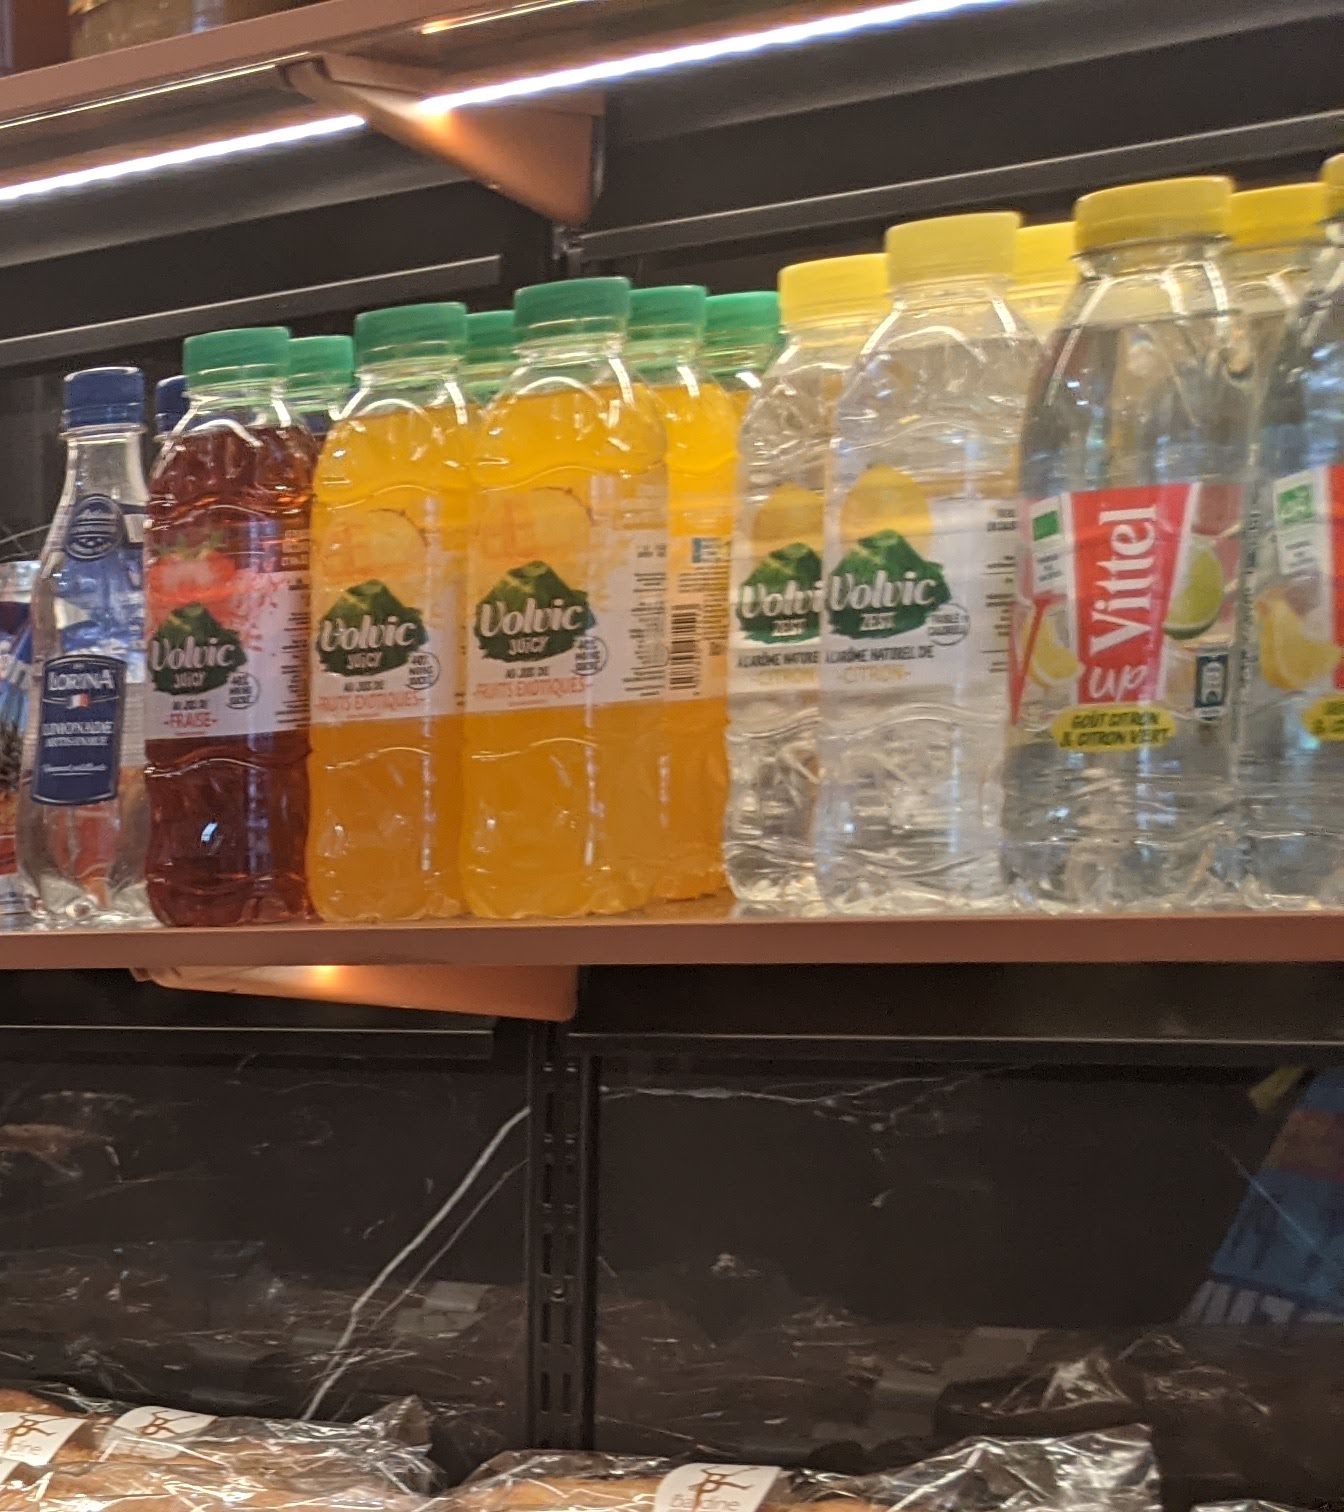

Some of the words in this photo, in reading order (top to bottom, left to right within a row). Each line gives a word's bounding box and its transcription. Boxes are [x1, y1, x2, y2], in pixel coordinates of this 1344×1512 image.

[740, 579, 824, 619] Volvi
[828, 569, 938, 612] Volvic
[1088, 504, 1157, 657] Vittel
[320, 614, 418, 653] Volvic
[480, 597, 585, 638] Volvic
[150, 635, 236, 672] Volvic
[783, 650, 820, 665] NATURE
[1088, 662, 1150, 702] up
